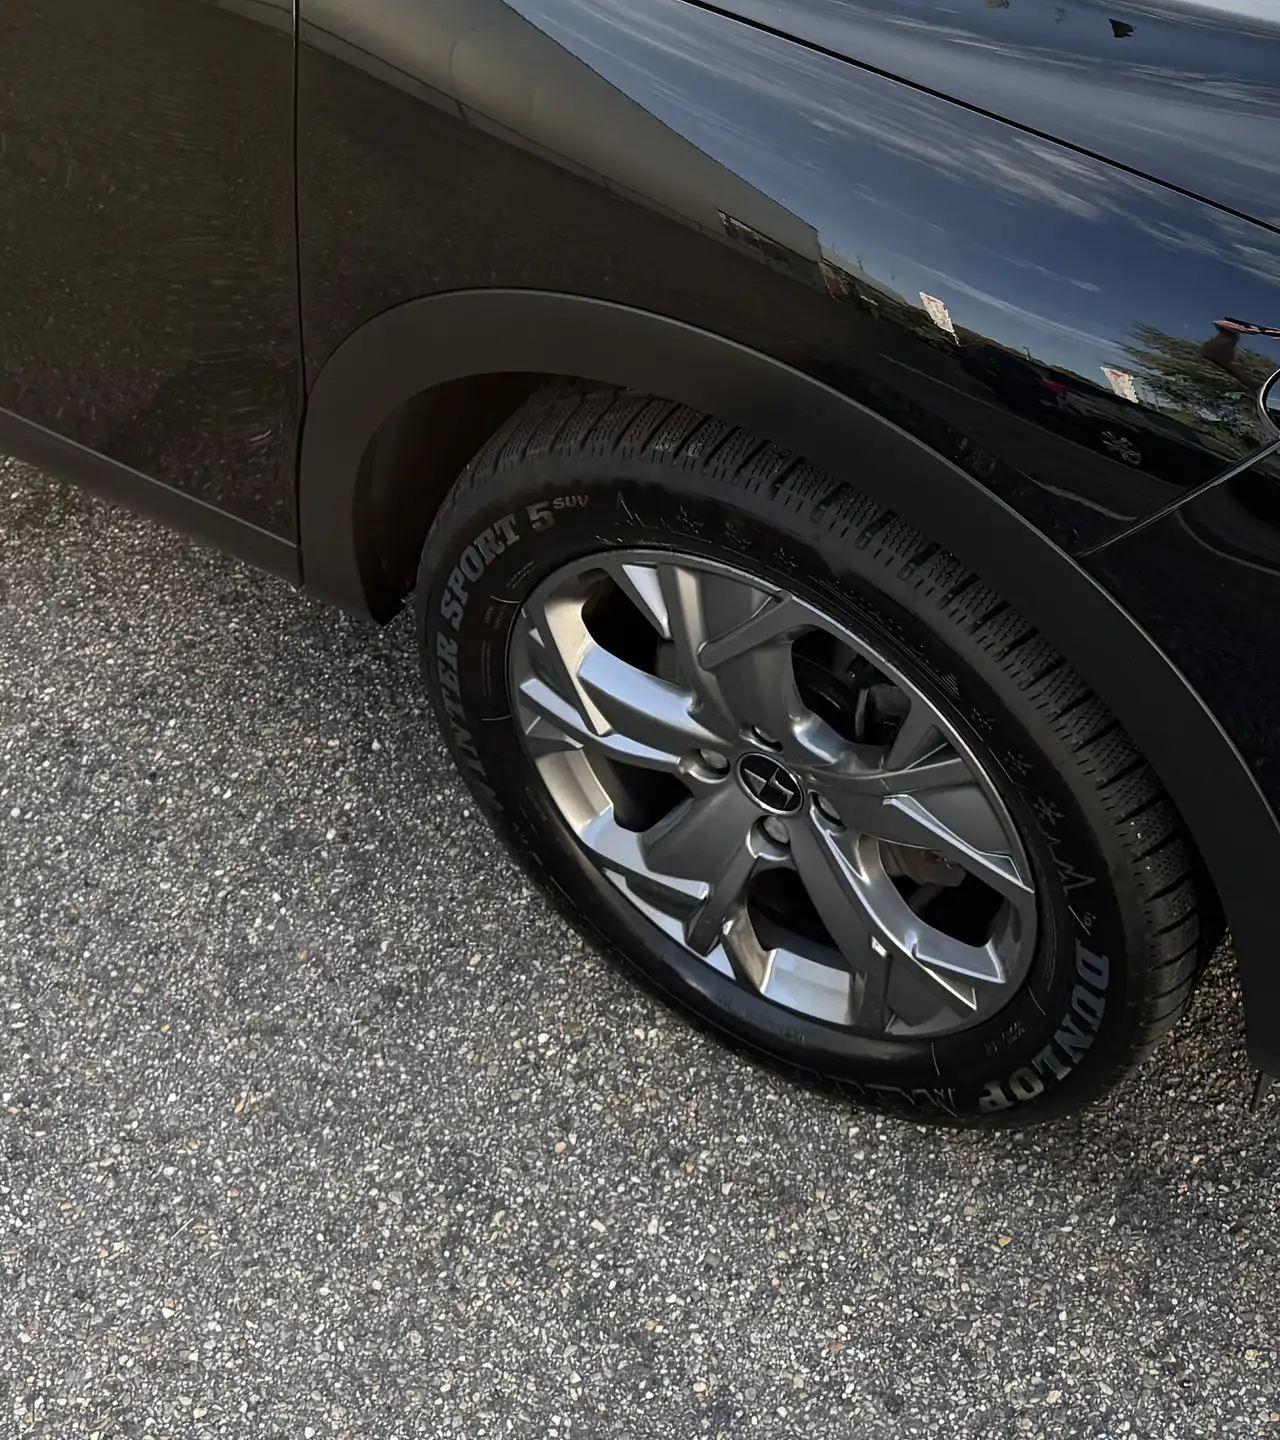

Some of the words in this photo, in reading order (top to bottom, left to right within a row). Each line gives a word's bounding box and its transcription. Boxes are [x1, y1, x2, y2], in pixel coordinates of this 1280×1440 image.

[441, 513, 520, 632] SPORT
[526, 502, 556, 533] 5
[553, 494, 590, 510] SUV
[978, 937, 1110, 1113] DUNLOP
